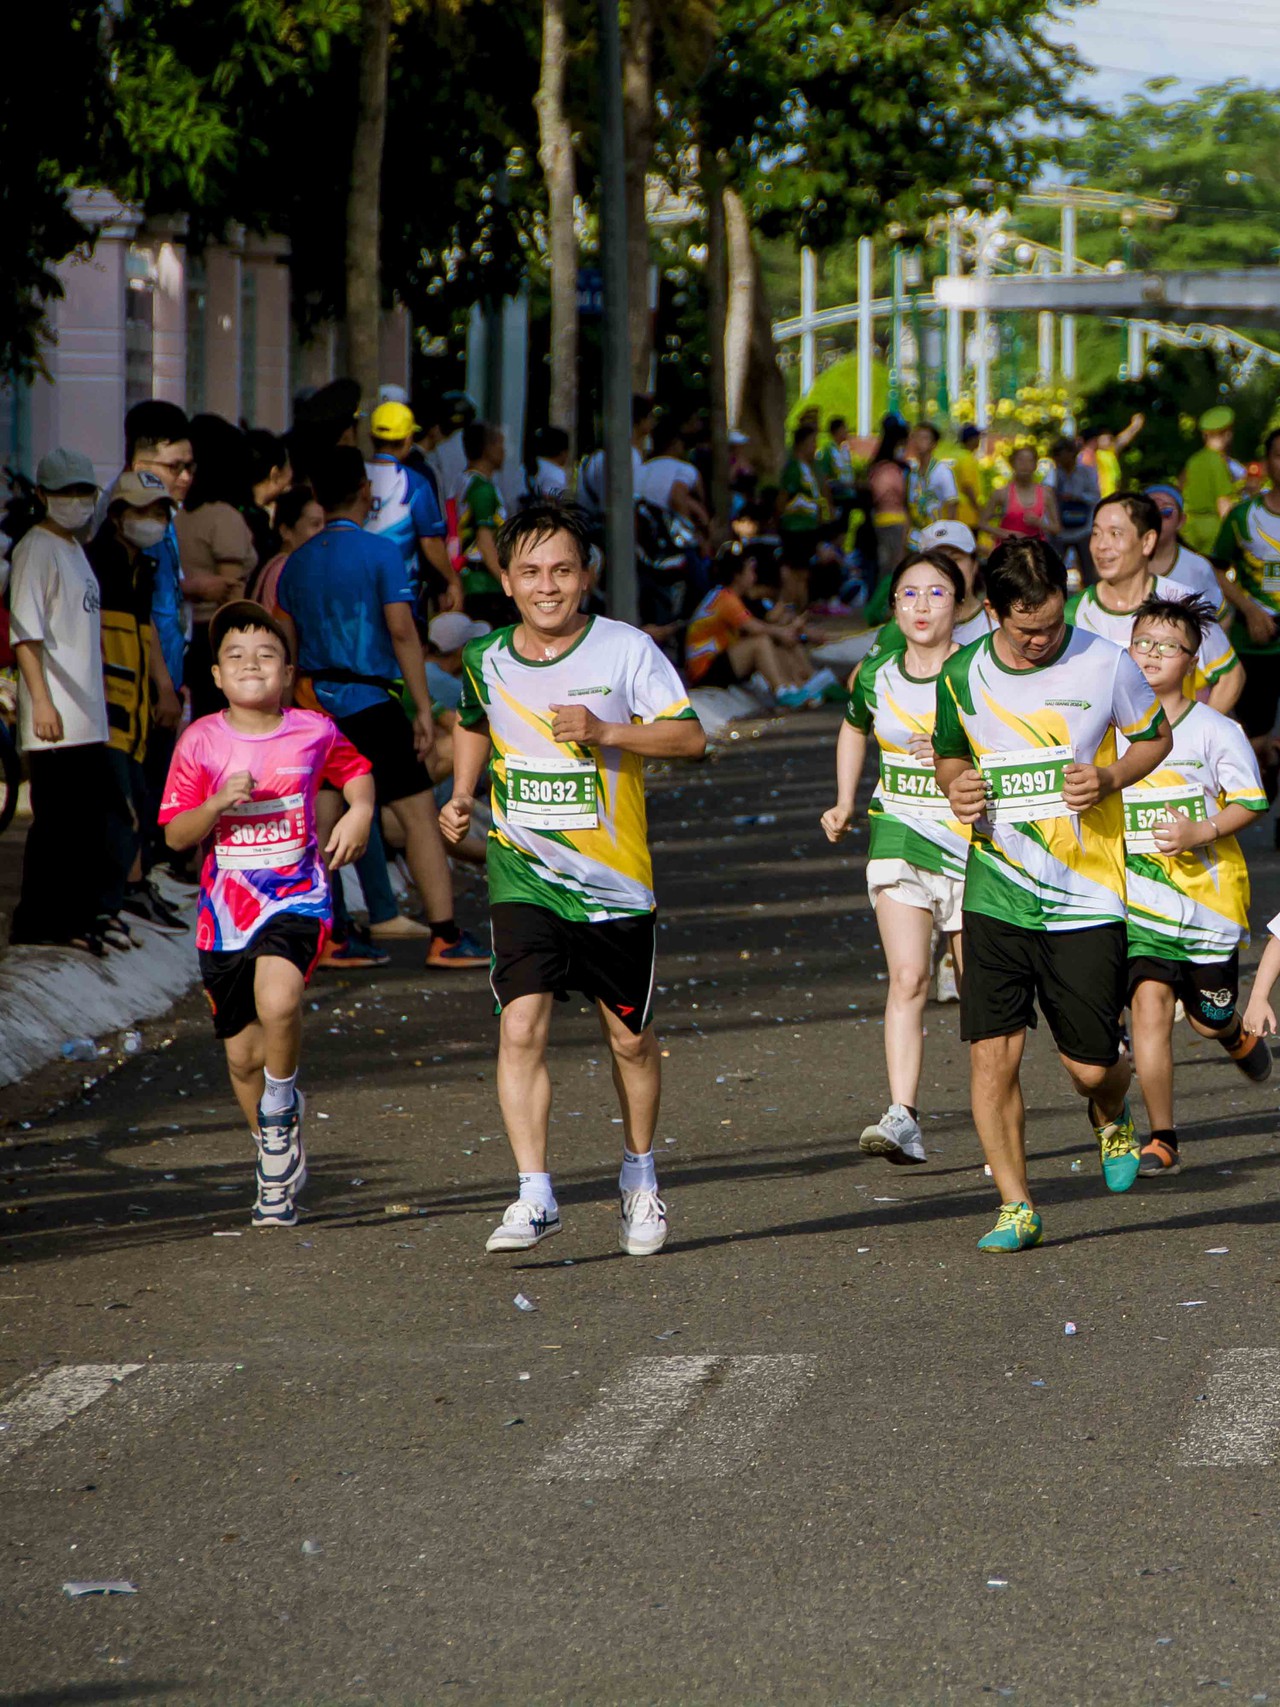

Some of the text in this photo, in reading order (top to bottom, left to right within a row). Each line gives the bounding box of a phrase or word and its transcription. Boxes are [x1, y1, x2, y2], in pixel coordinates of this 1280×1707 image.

[520, 778, 577, 802] 53032
[1001, 769, 1056, 796] 52997
[231, 819, 291, 845] 30230
